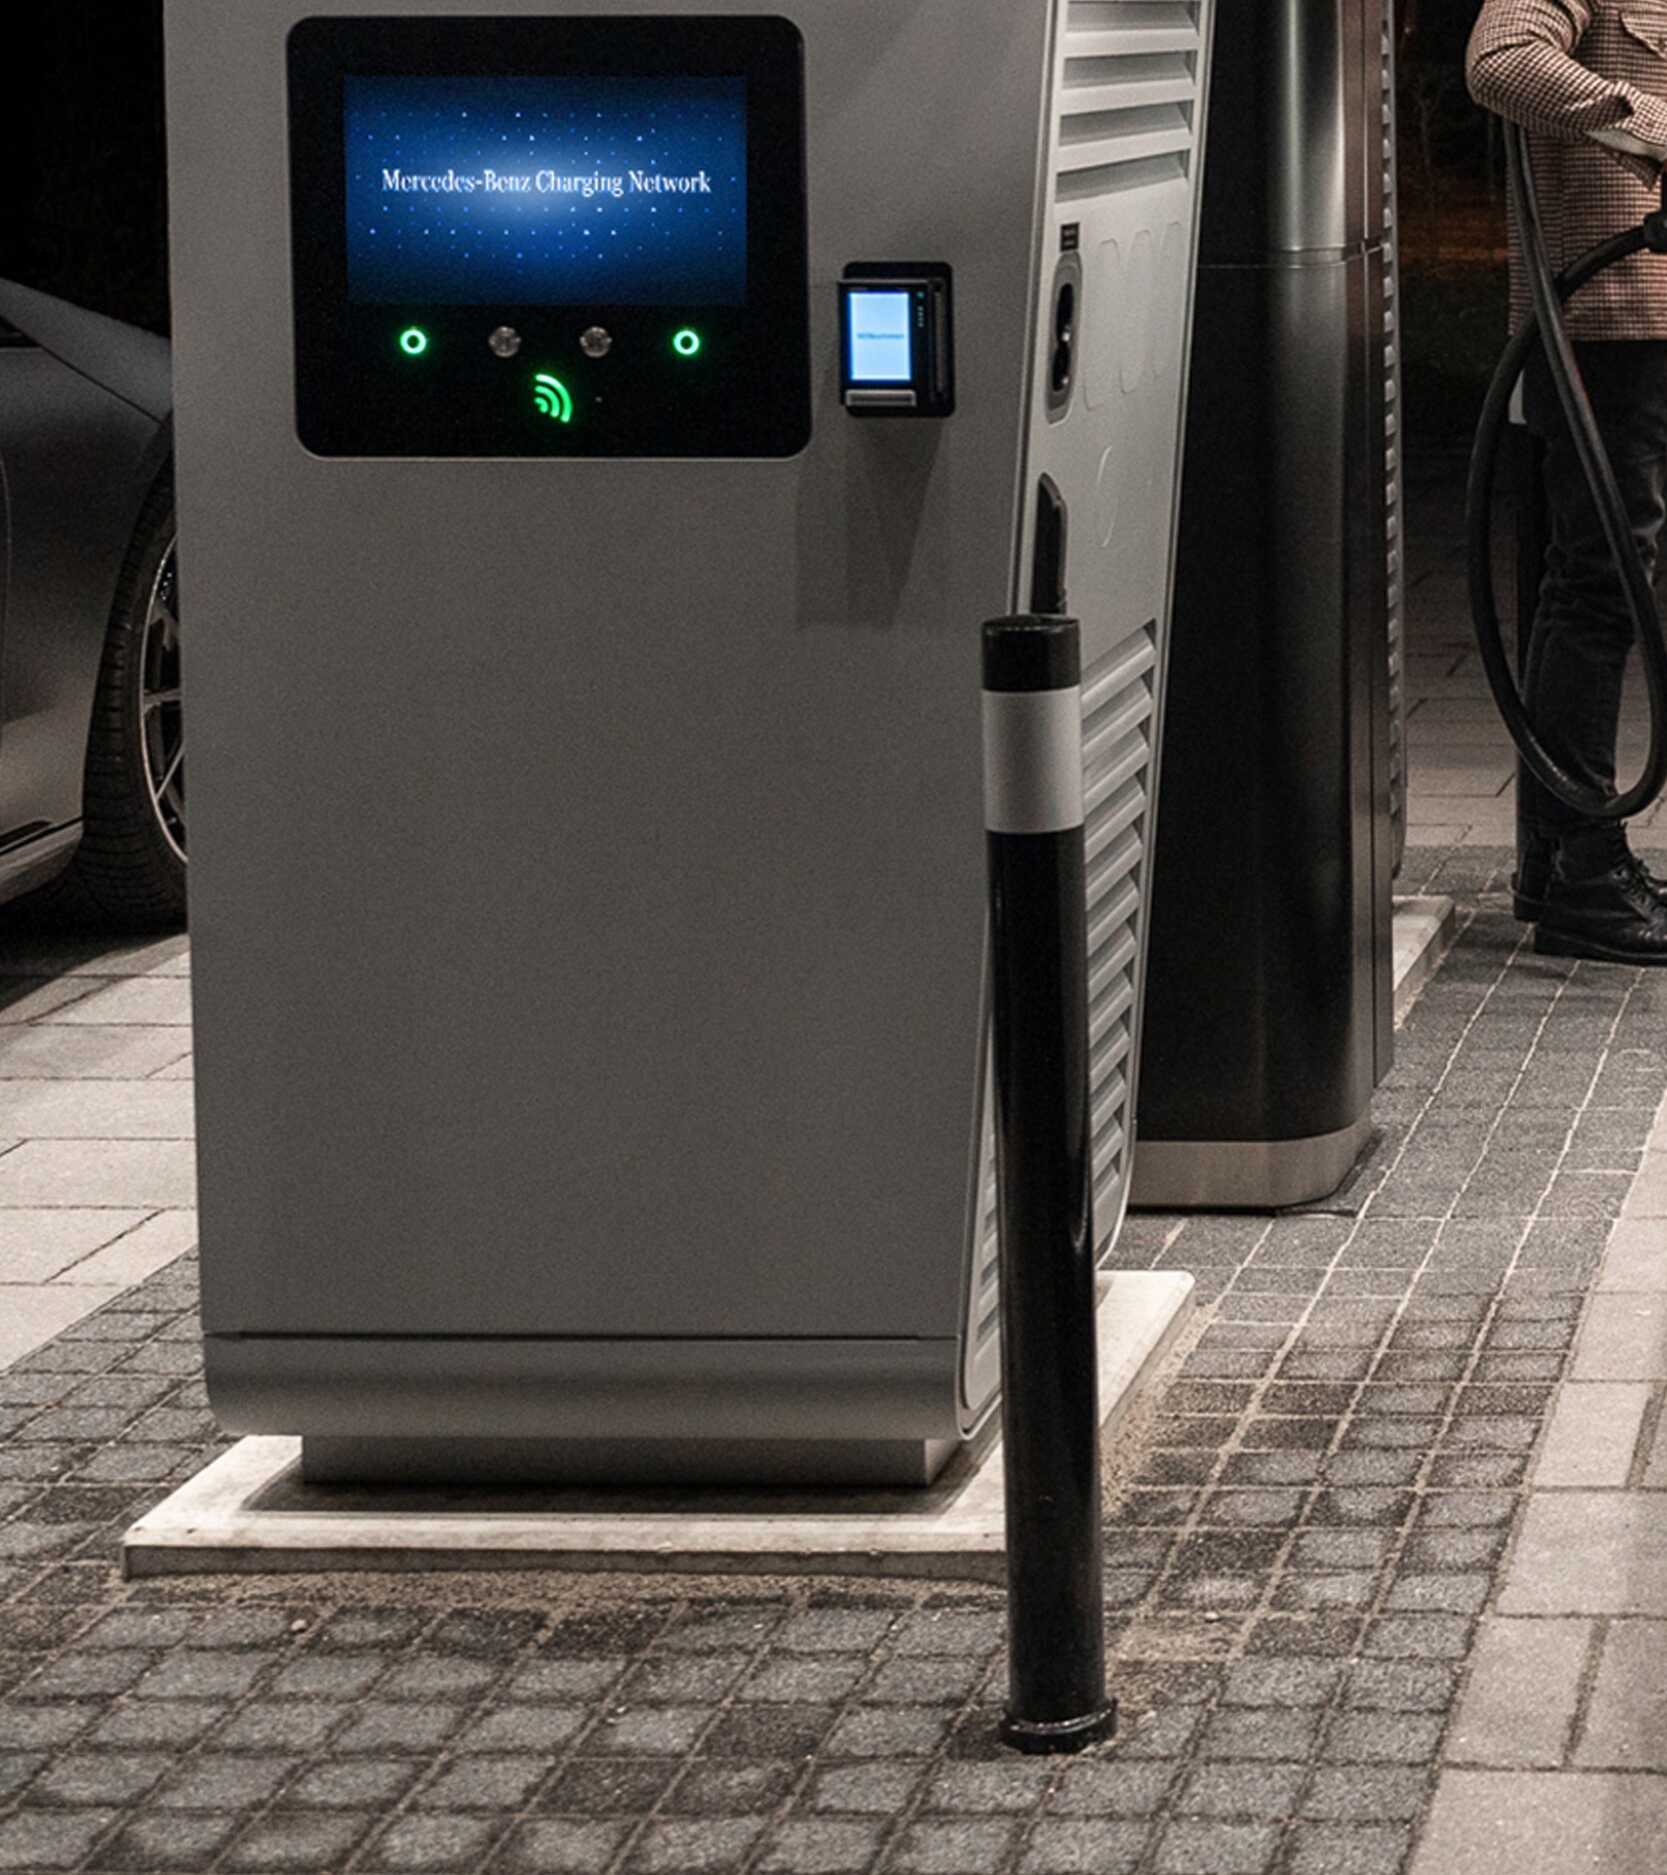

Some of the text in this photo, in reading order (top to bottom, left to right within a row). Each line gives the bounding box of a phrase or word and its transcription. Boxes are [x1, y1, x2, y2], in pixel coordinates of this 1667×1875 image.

[381, 169, 712, 197] Mercedes-Benz Charging Network
